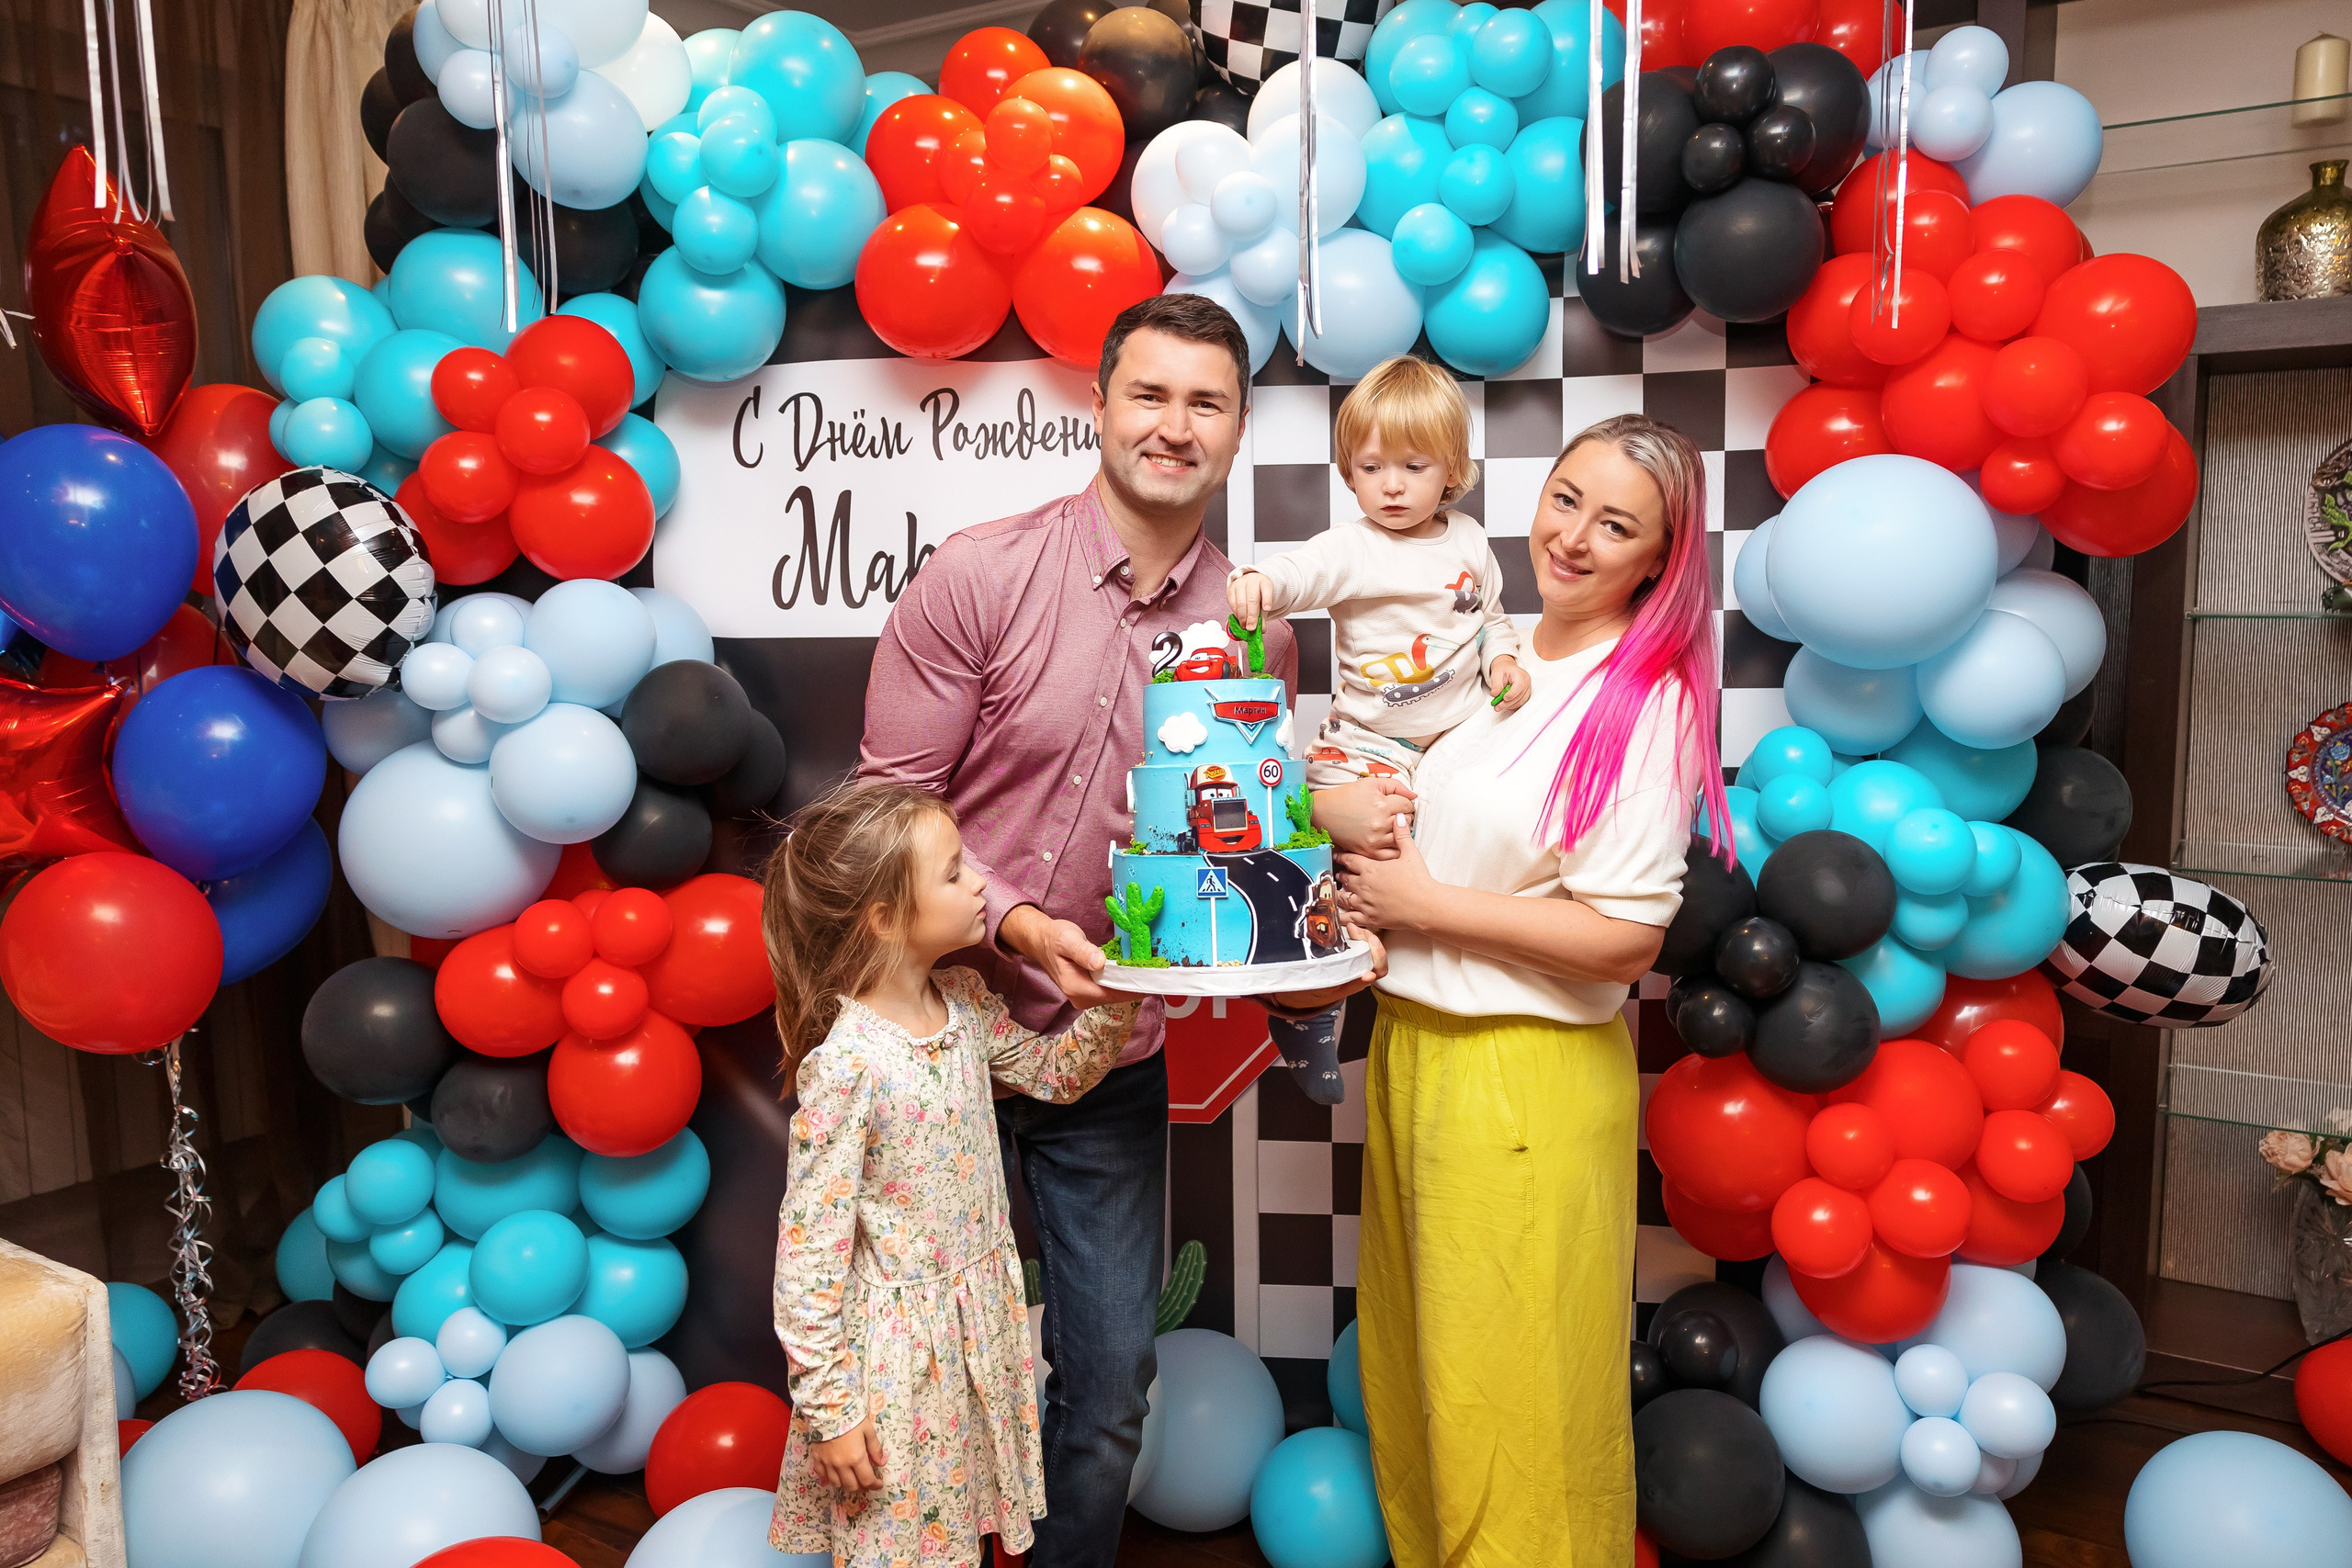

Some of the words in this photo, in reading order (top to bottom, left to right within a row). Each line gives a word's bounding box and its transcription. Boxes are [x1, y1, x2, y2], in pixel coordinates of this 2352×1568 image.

[733, 385, 763, 468] С
[777, 391, 913, 471] Днём
[1151, 631, 1183, 678] 2
[1234, 705, 1267, 716] Мартин
[1263, 765, 1279, 778] 60
